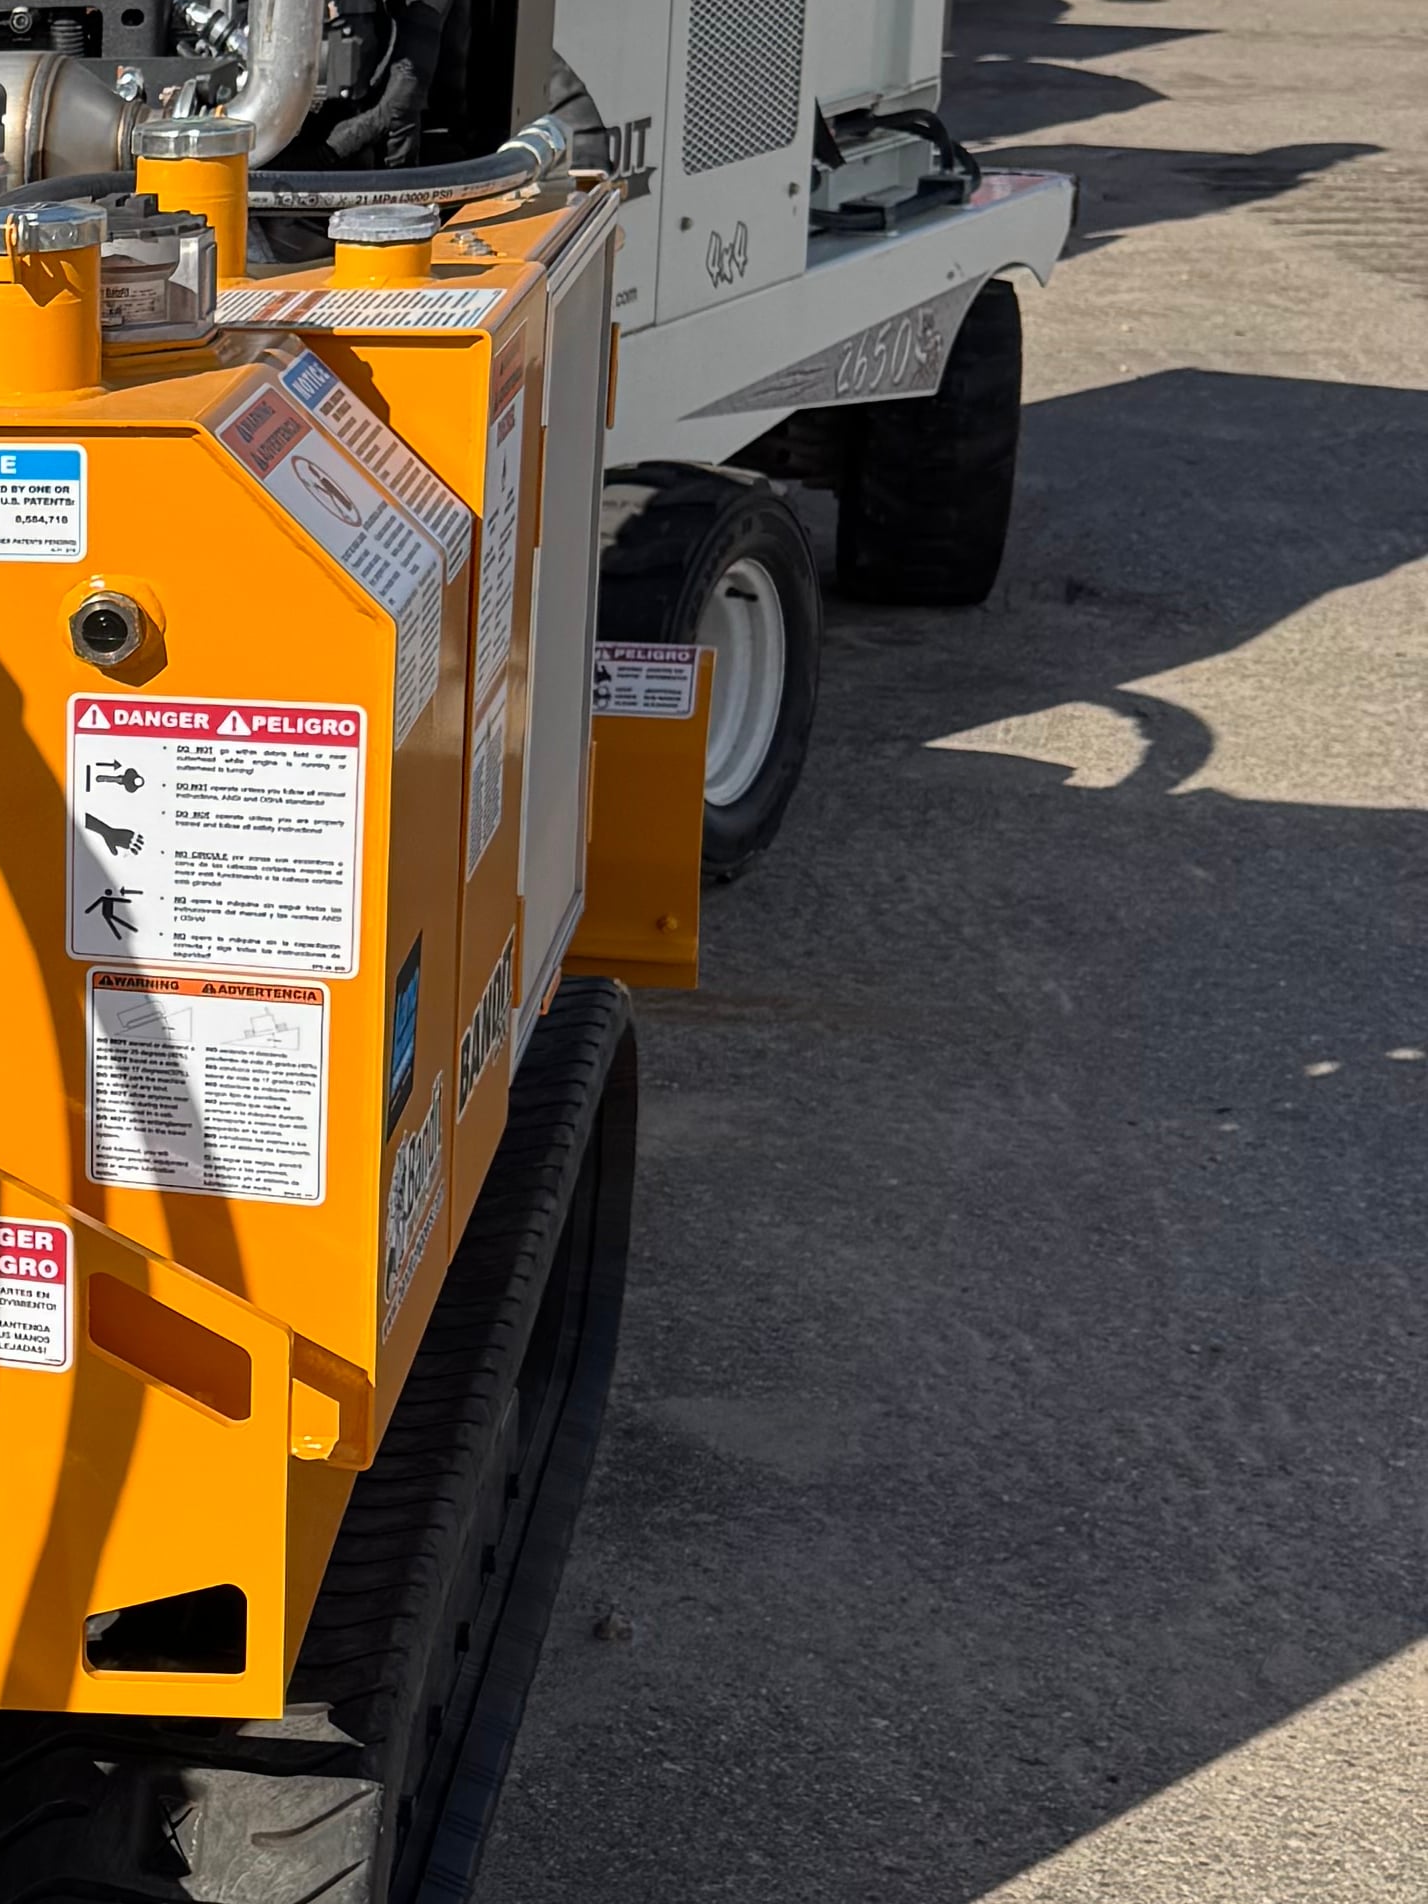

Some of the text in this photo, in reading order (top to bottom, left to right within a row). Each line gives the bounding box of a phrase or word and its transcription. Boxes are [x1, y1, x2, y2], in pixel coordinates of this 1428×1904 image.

[355, 195, 369, 205] 21
[373, 194, 396, 204] MPa
[838, 318, 911, 394] 2650
[292, 361, 331, 401] NOTICE
[28, 486, 50, 494] ONE
[1, 498, 20, 506] U.S.
[24, 498, 75, 506] PATENTS:
[614, 649, 690, 661] PELIGRO
[114, 709, 210, 730] DANGER
[251, 715, 356, 737] PELIGRO
[113, 978, 179, 990] WARNING
[218, 985, 317, 1001] ADVERTENCIA
[458, 926, 515, 1118] BANDIT
[36, 1289, 50, 1298] EN
[14, 1332, 50, 1343] MANOS
